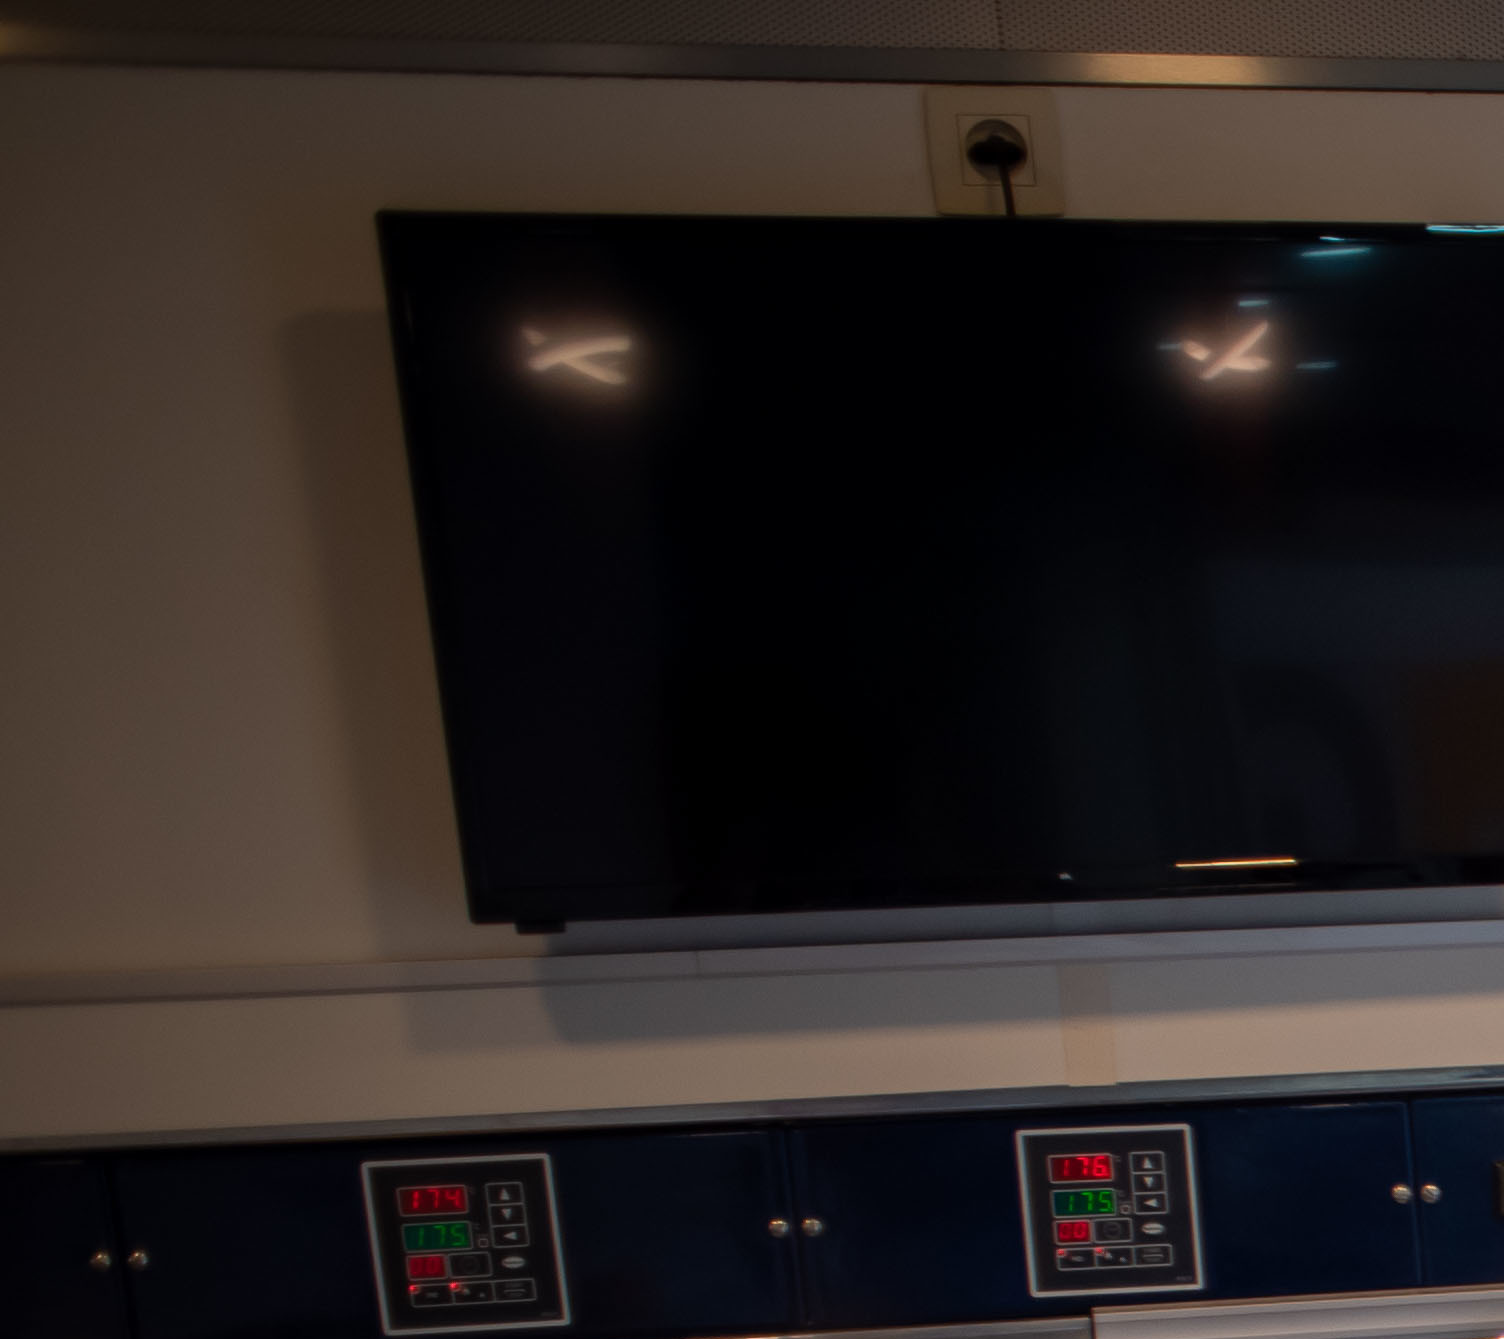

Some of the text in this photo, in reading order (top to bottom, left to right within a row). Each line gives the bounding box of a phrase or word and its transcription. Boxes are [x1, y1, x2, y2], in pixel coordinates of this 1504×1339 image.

[1063, 1154, 1110, 1178] 176
[411, 1187, 461, 1210] 174
[1067, 1191, 1113, 1213] 175
[417, 1222, 467, 1246] 175
